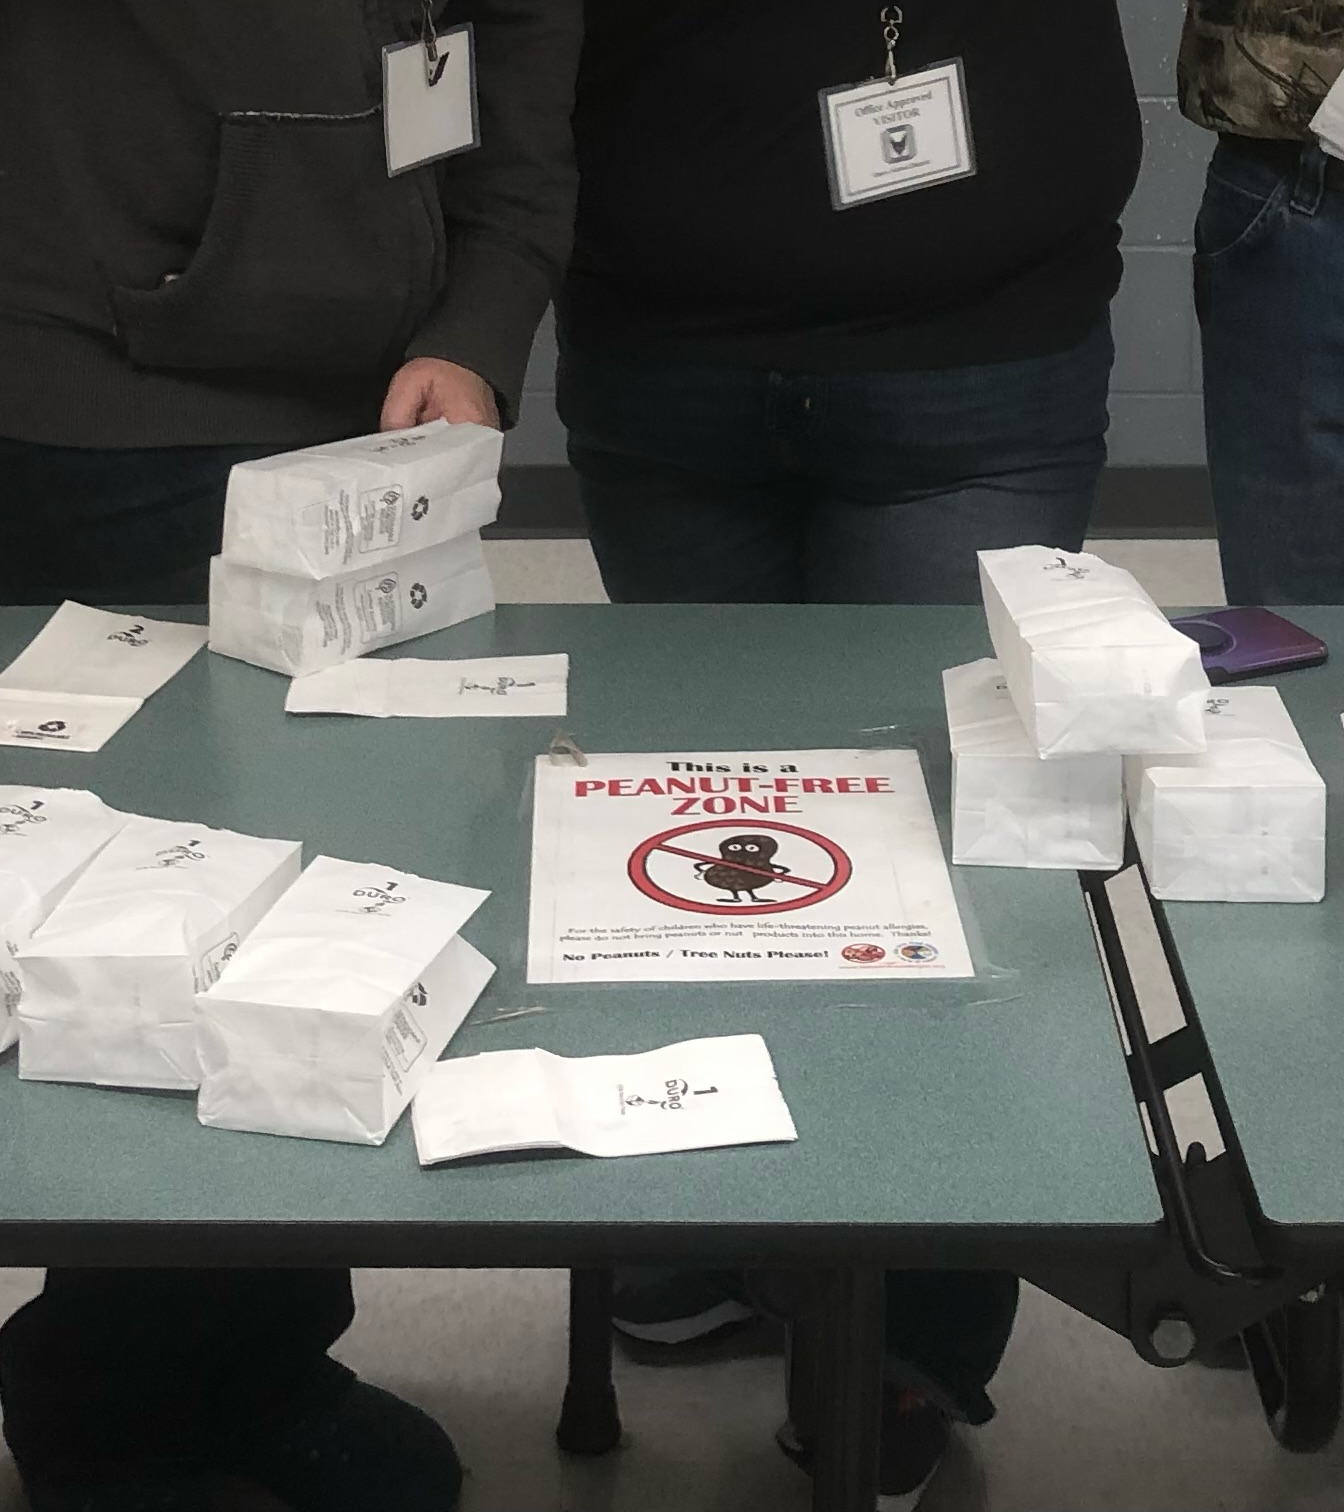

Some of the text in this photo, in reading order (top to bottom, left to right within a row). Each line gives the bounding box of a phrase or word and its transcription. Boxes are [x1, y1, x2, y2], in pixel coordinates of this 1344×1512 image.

[129, 624, 144, 635] 2
[666, 760, 801, 774] This is a
[574, 776, 896, 797] PEANUT-FREE
[670, 795, 804, 816] ZONE
[386, 881, 399, 892] 1
[352, 889, 407, 904] DURO
[562, 949, 830, 961] No Peanuts / Tree Nuts Please!
[665, 1079, 682, 1110] DURO
[693, 1085, 719, 1096] 1
